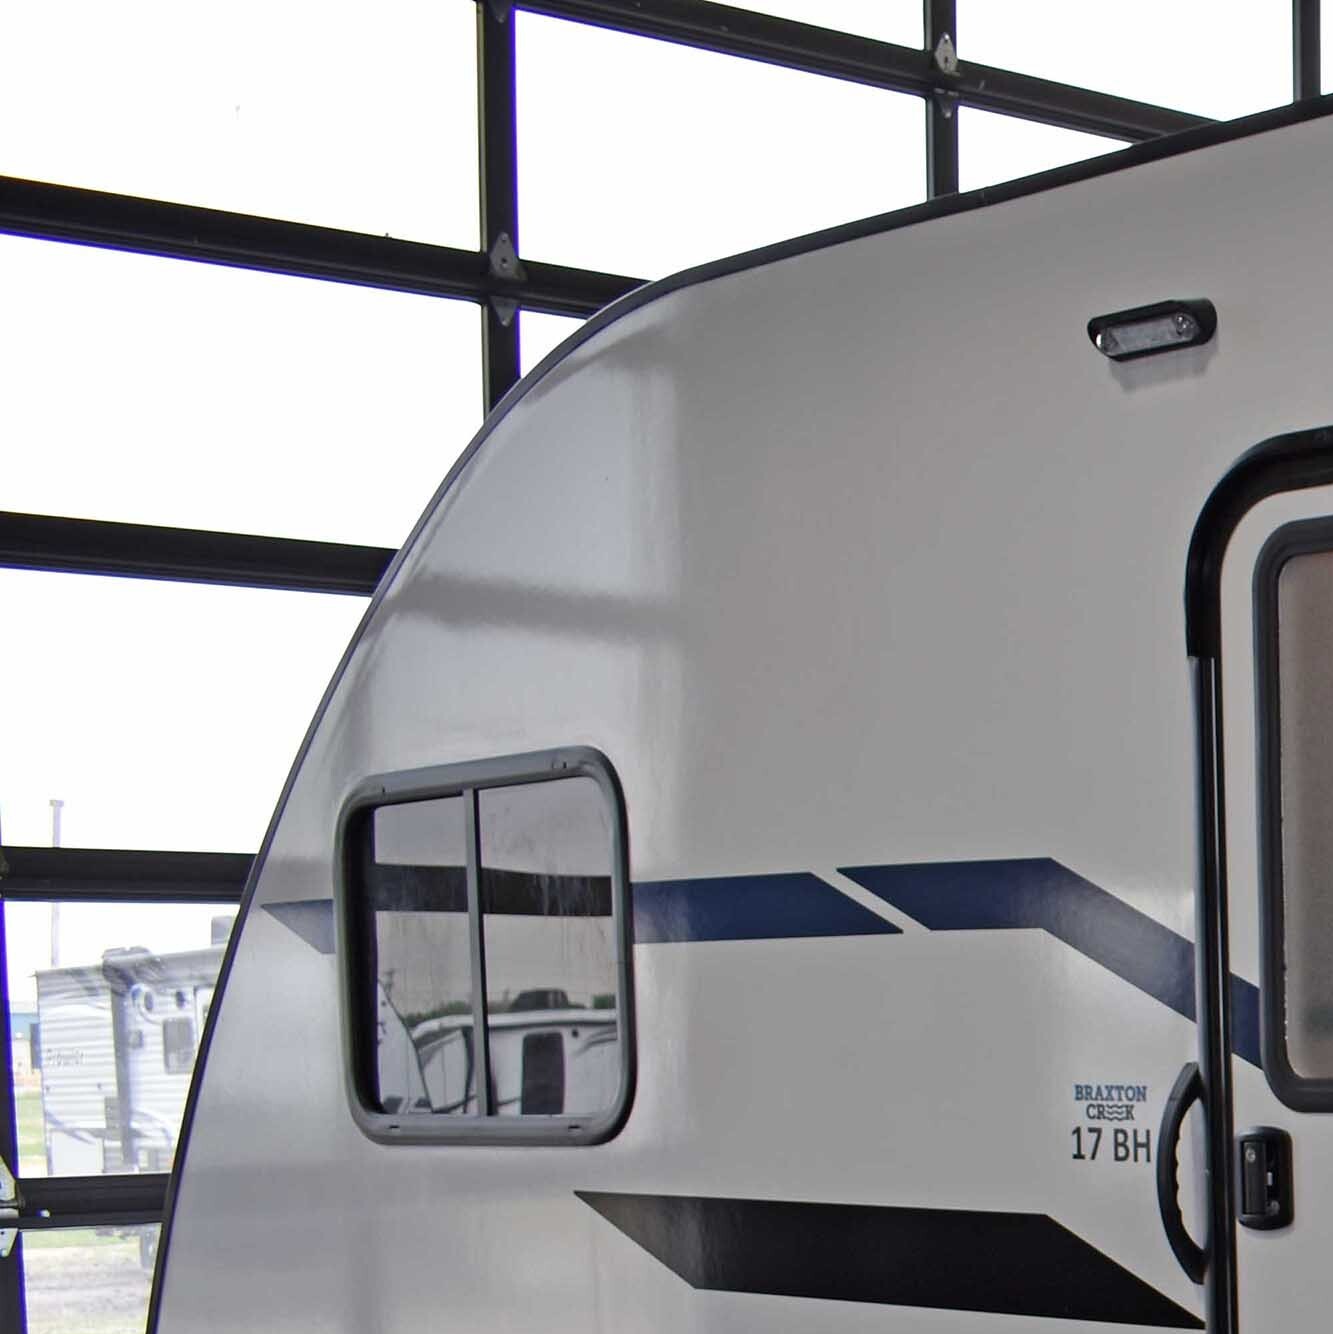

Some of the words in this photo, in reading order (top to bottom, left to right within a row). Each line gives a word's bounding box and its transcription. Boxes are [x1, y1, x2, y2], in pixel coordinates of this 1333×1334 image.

[1074, 1084, 1148, 1102] BRAXTON
[1071, 1126, 1102, 1160] 17
[1113, 1128, 1151, 1163] BH
